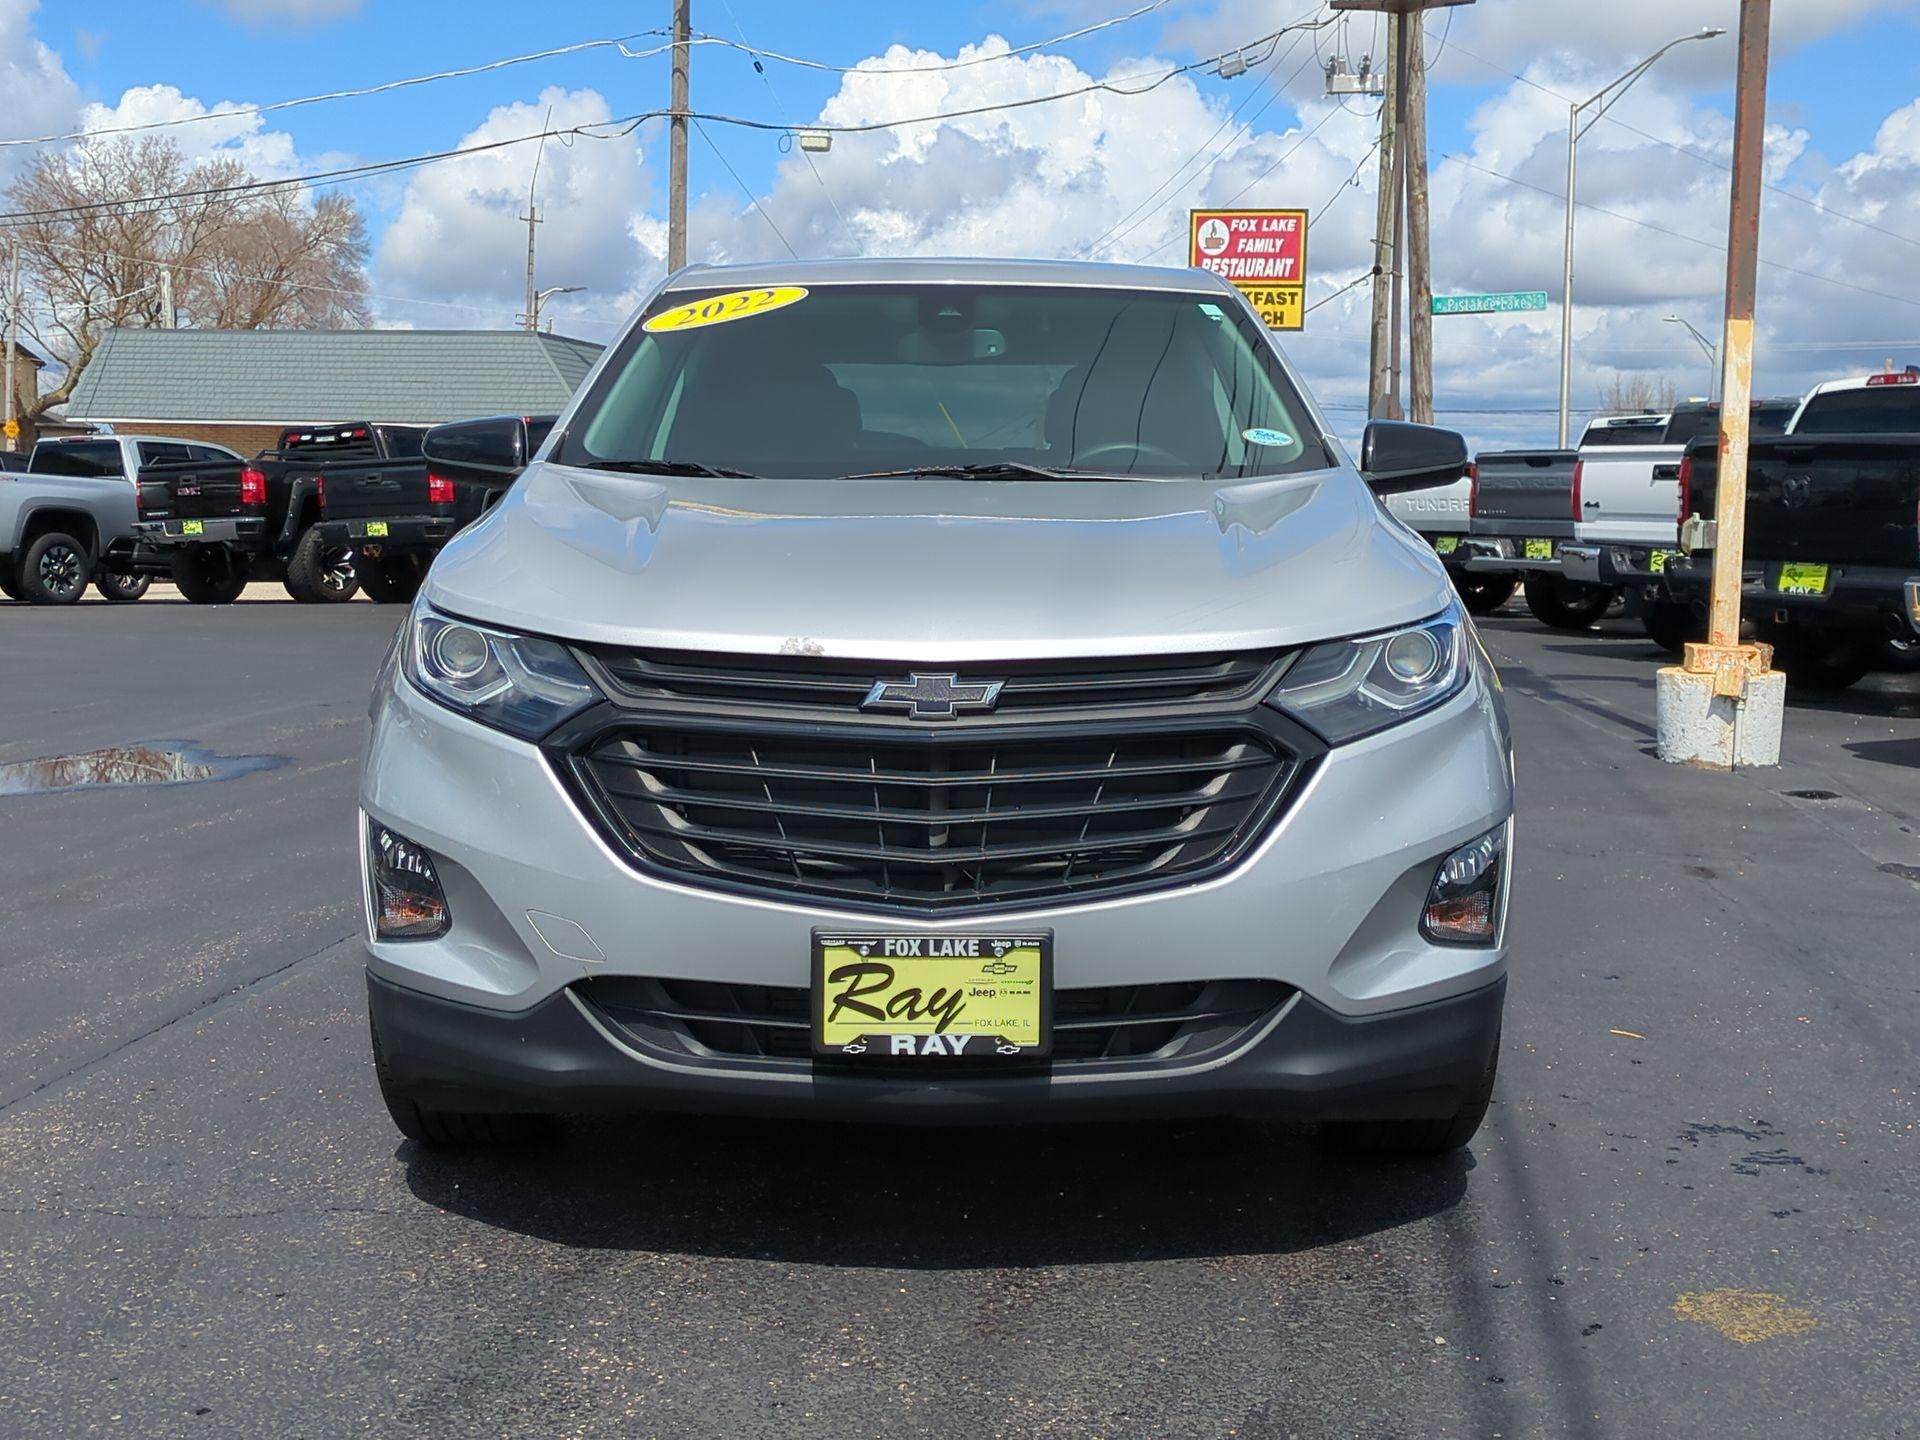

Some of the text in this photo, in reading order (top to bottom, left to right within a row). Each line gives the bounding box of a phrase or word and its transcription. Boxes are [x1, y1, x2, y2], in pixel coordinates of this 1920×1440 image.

[1230, 219, 1297, 232] FOX LAKE
[1237, 239, 1284, 253] FAMILY
[1202, 258, 1295, 277] RESTAURANT
[674, 290, 775, 326] 2022
[884, 940, 979, 957] FOX LAKE
[991, 939, 1012, 948] Jeep
[828, 962, 967, 1034] Ray
[968, 987, 996, 998] Jeep
[974, 1019, 992, 1027] FOX
[1022, 1019, 1031, 1027] IL
[890, 1035, 972, 1055] RAY
